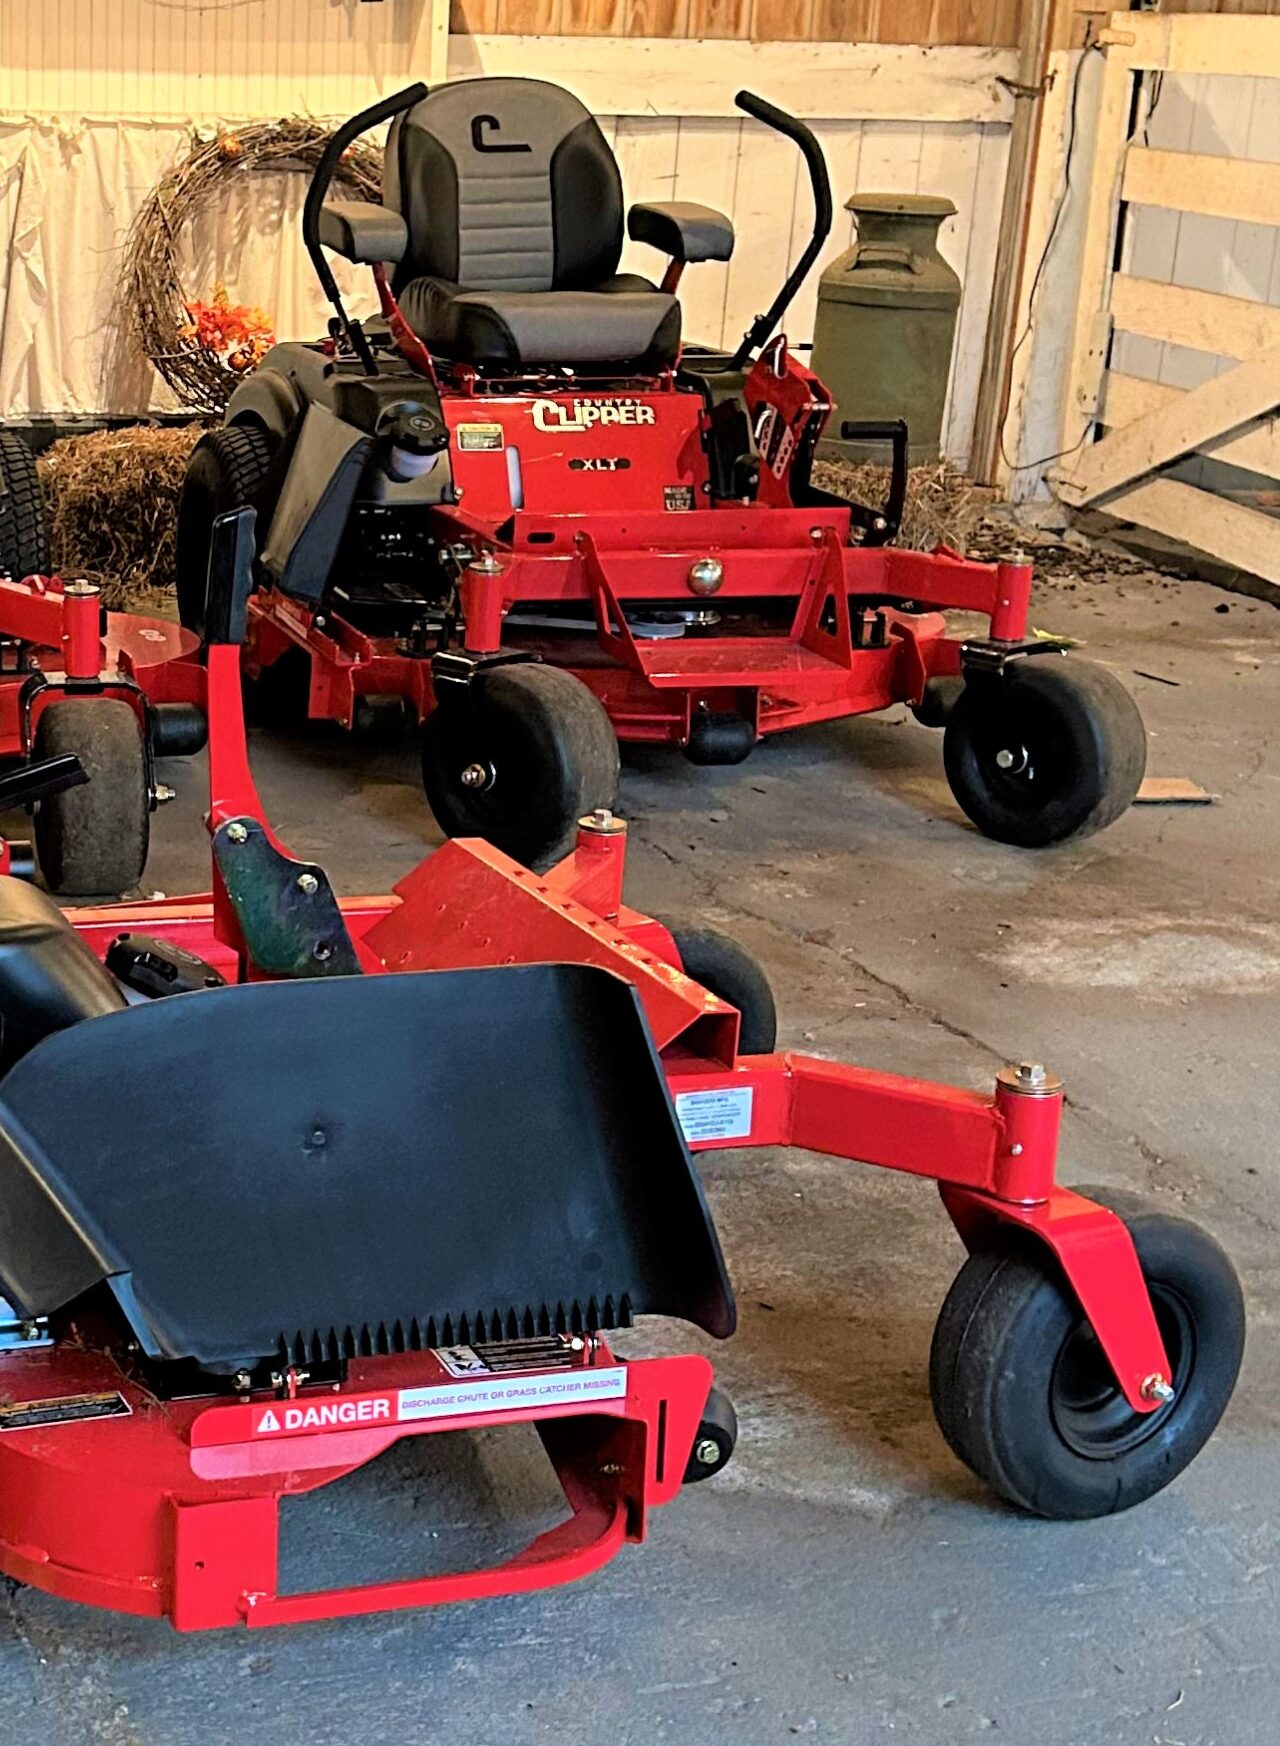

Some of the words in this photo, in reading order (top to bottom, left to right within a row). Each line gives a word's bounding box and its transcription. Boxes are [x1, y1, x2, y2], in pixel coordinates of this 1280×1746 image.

[573, 398, 642, 407] COUNTRY
[531, 399, 656, 432] CLIPPER
[582, 458, 618, 471] XLT
[285, 1399, 390, 1429] DANGER
[401, 1395, 455, 1410] DISCHARGE
[457, 1392, 489, 1404] CHUTE
[490, 1390, 505, 1400] OR
[506, 1387, 537, 1398] GRASS
[539, 1383, 582, 1395] CATCHER
[583, 1378, 621, 1390] MISSING
